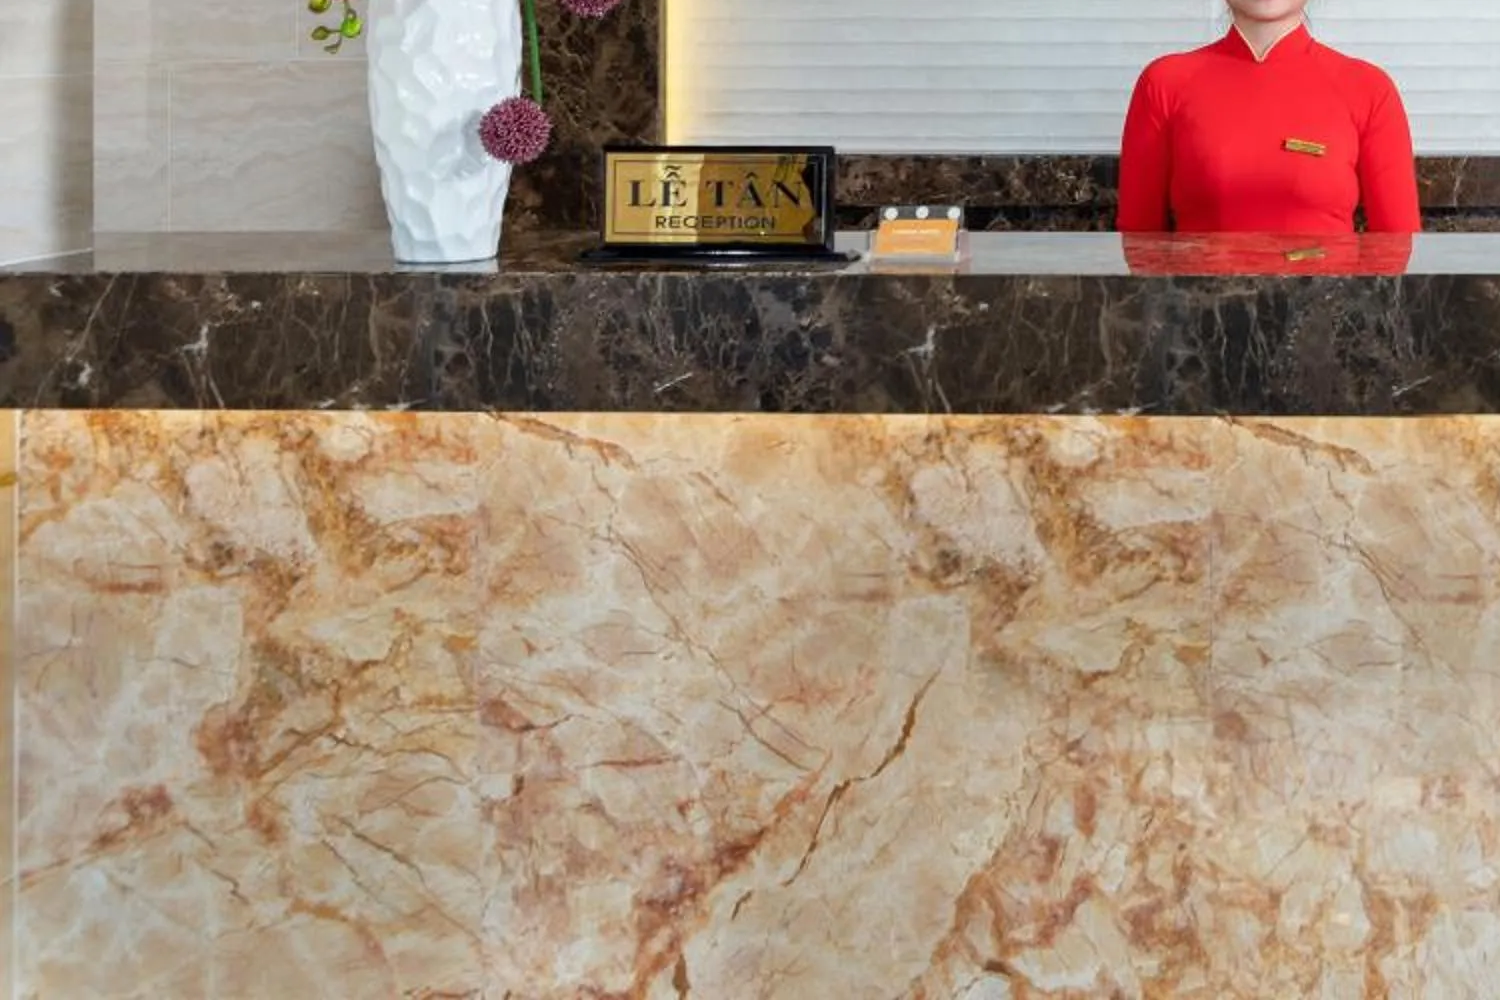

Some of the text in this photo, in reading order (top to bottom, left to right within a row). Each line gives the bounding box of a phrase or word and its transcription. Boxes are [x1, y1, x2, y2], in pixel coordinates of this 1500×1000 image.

[628, 165, 802, 209] LỄ TÂN
[655, 215, 776, 230] RECEPTION
